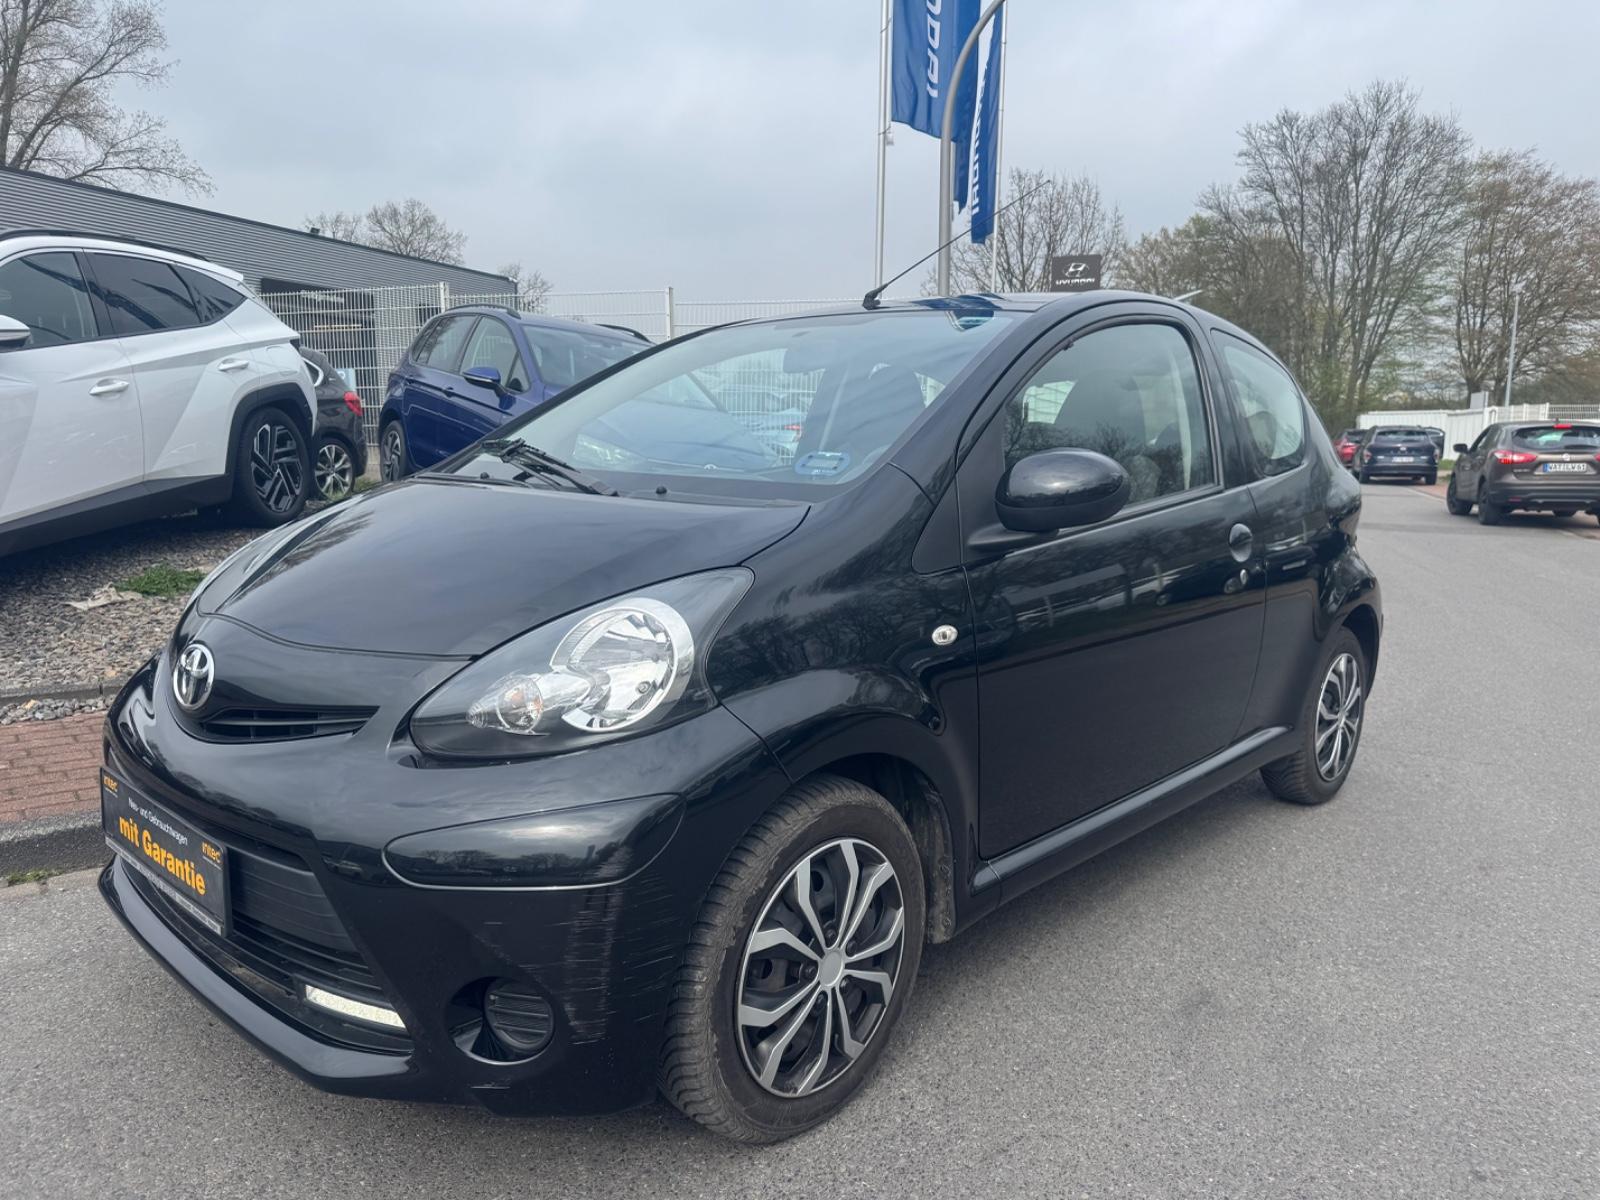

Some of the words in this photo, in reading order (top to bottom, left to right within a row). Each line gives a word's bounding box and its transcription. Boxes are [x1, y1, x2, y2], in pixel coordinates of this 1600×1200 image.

[119, 816, 140, 848] mit
[142, 829, 206, 896] Garantie
[148, 811, 188, 846] Gebrauchtwagen
